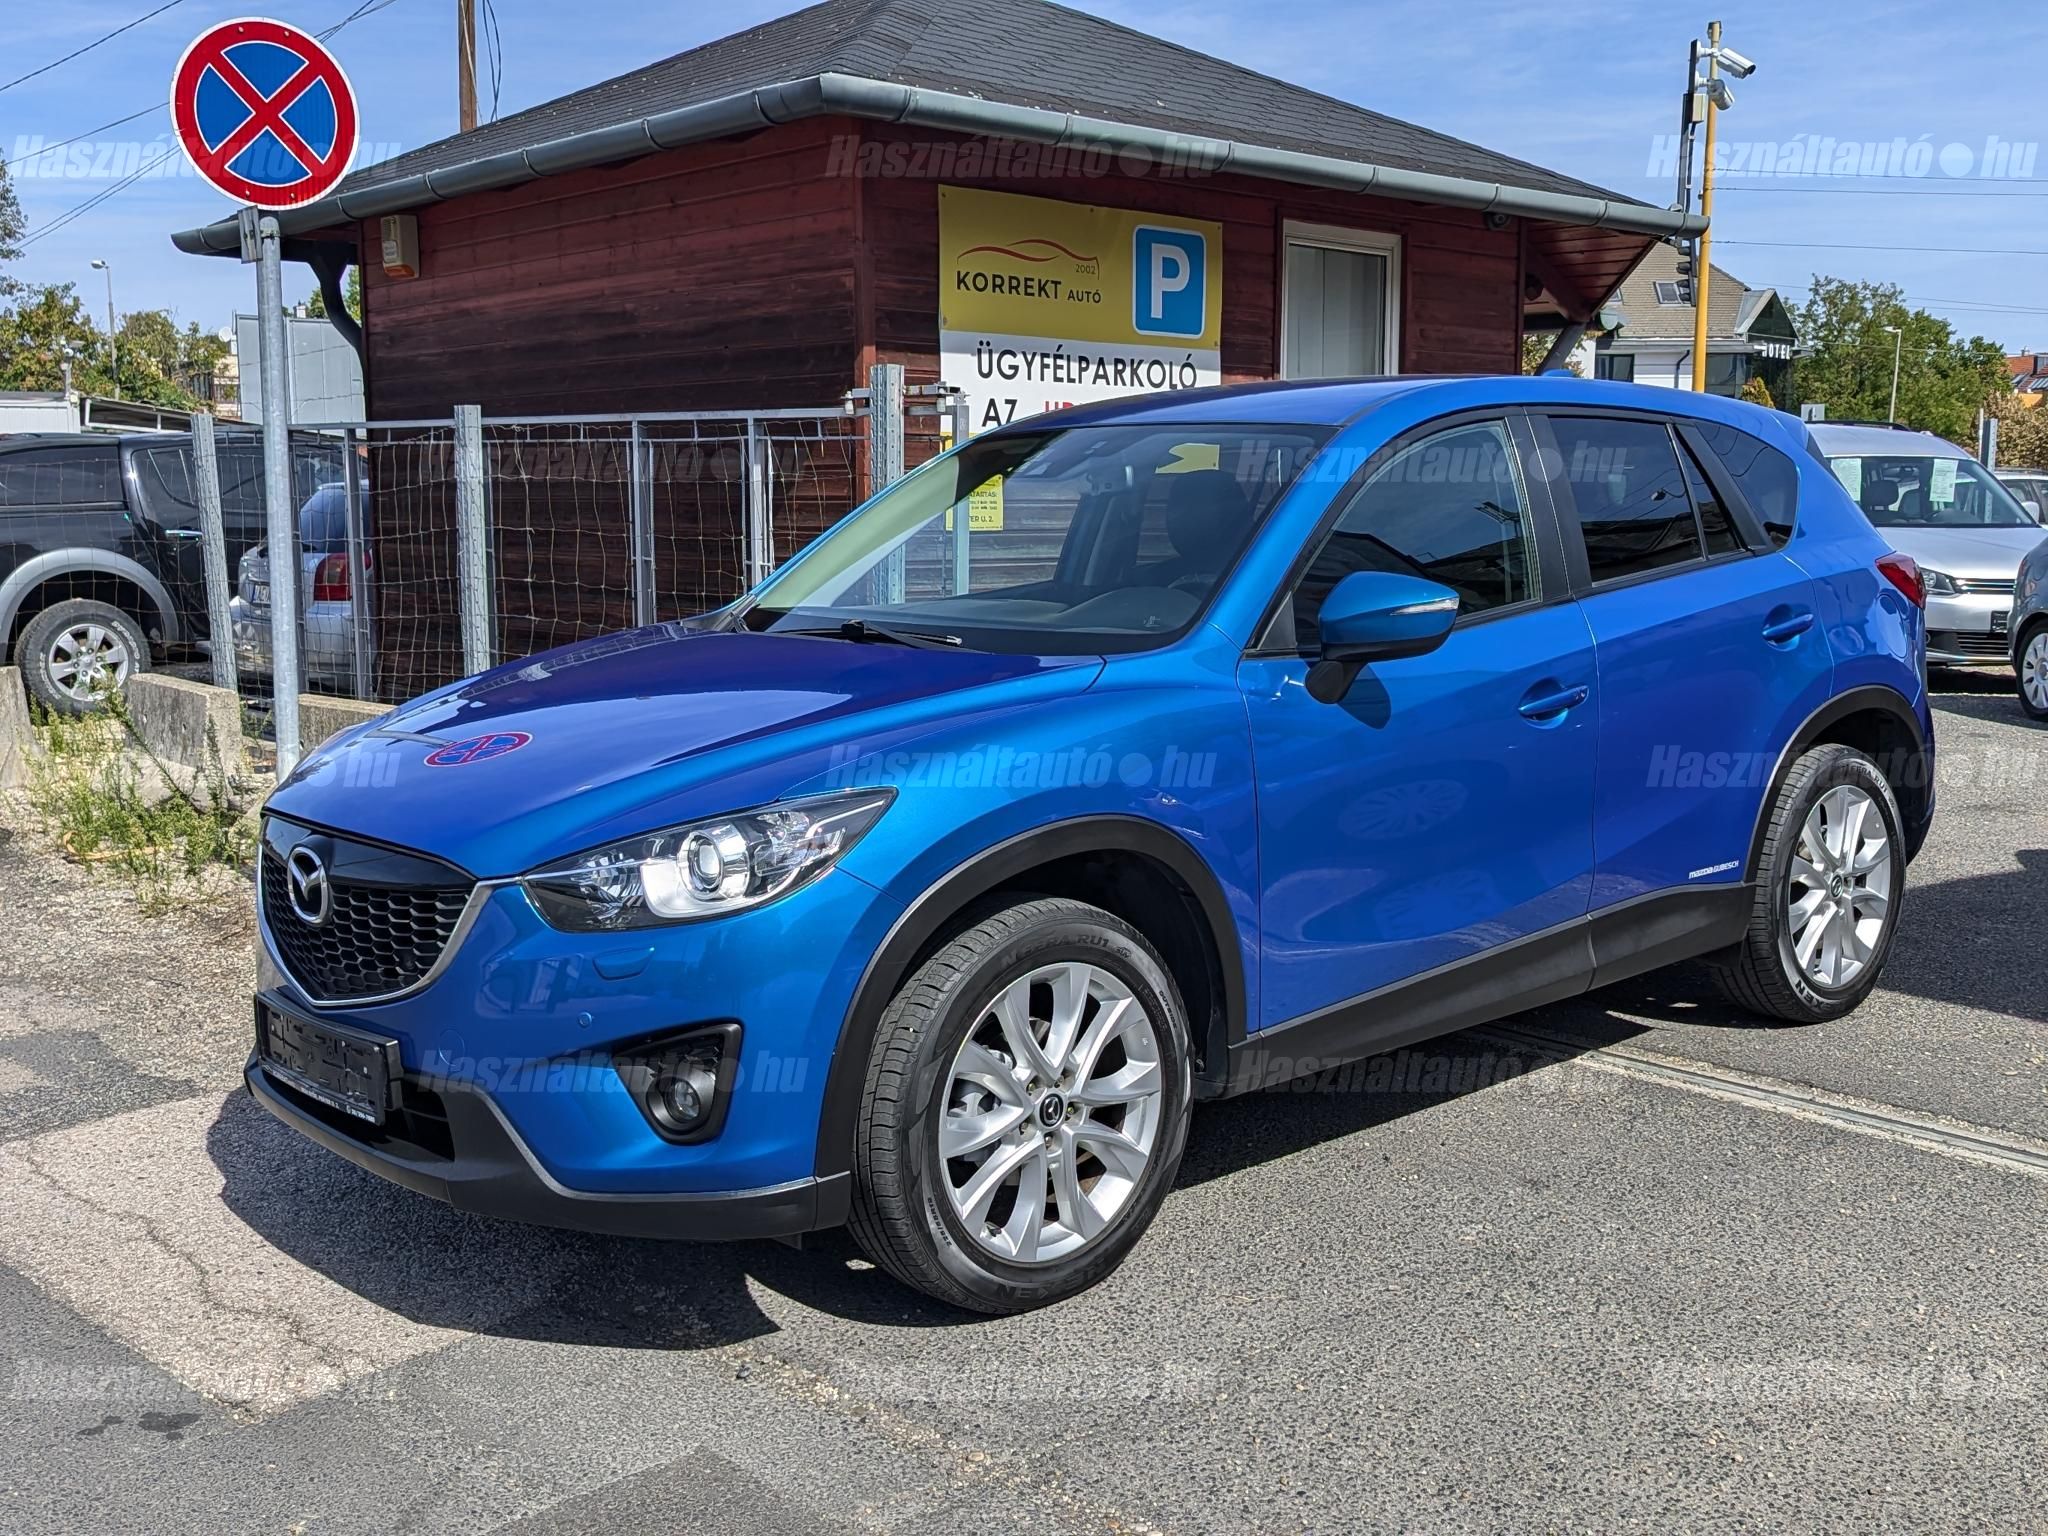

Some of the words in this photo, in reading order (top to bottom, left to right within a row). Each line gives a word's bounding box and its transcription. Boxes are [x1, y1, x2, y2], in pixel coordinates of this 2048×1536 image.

[956, 270, 1062, 300] KORREKT
[1067, 289, 1102, 304] AUTÓ
[1075, 263, 1096, 275] 2002
[1151, 243, 1190, 319] P
[976, 340, 1198, 389] ÜGYFÉLPARKOLÓ
